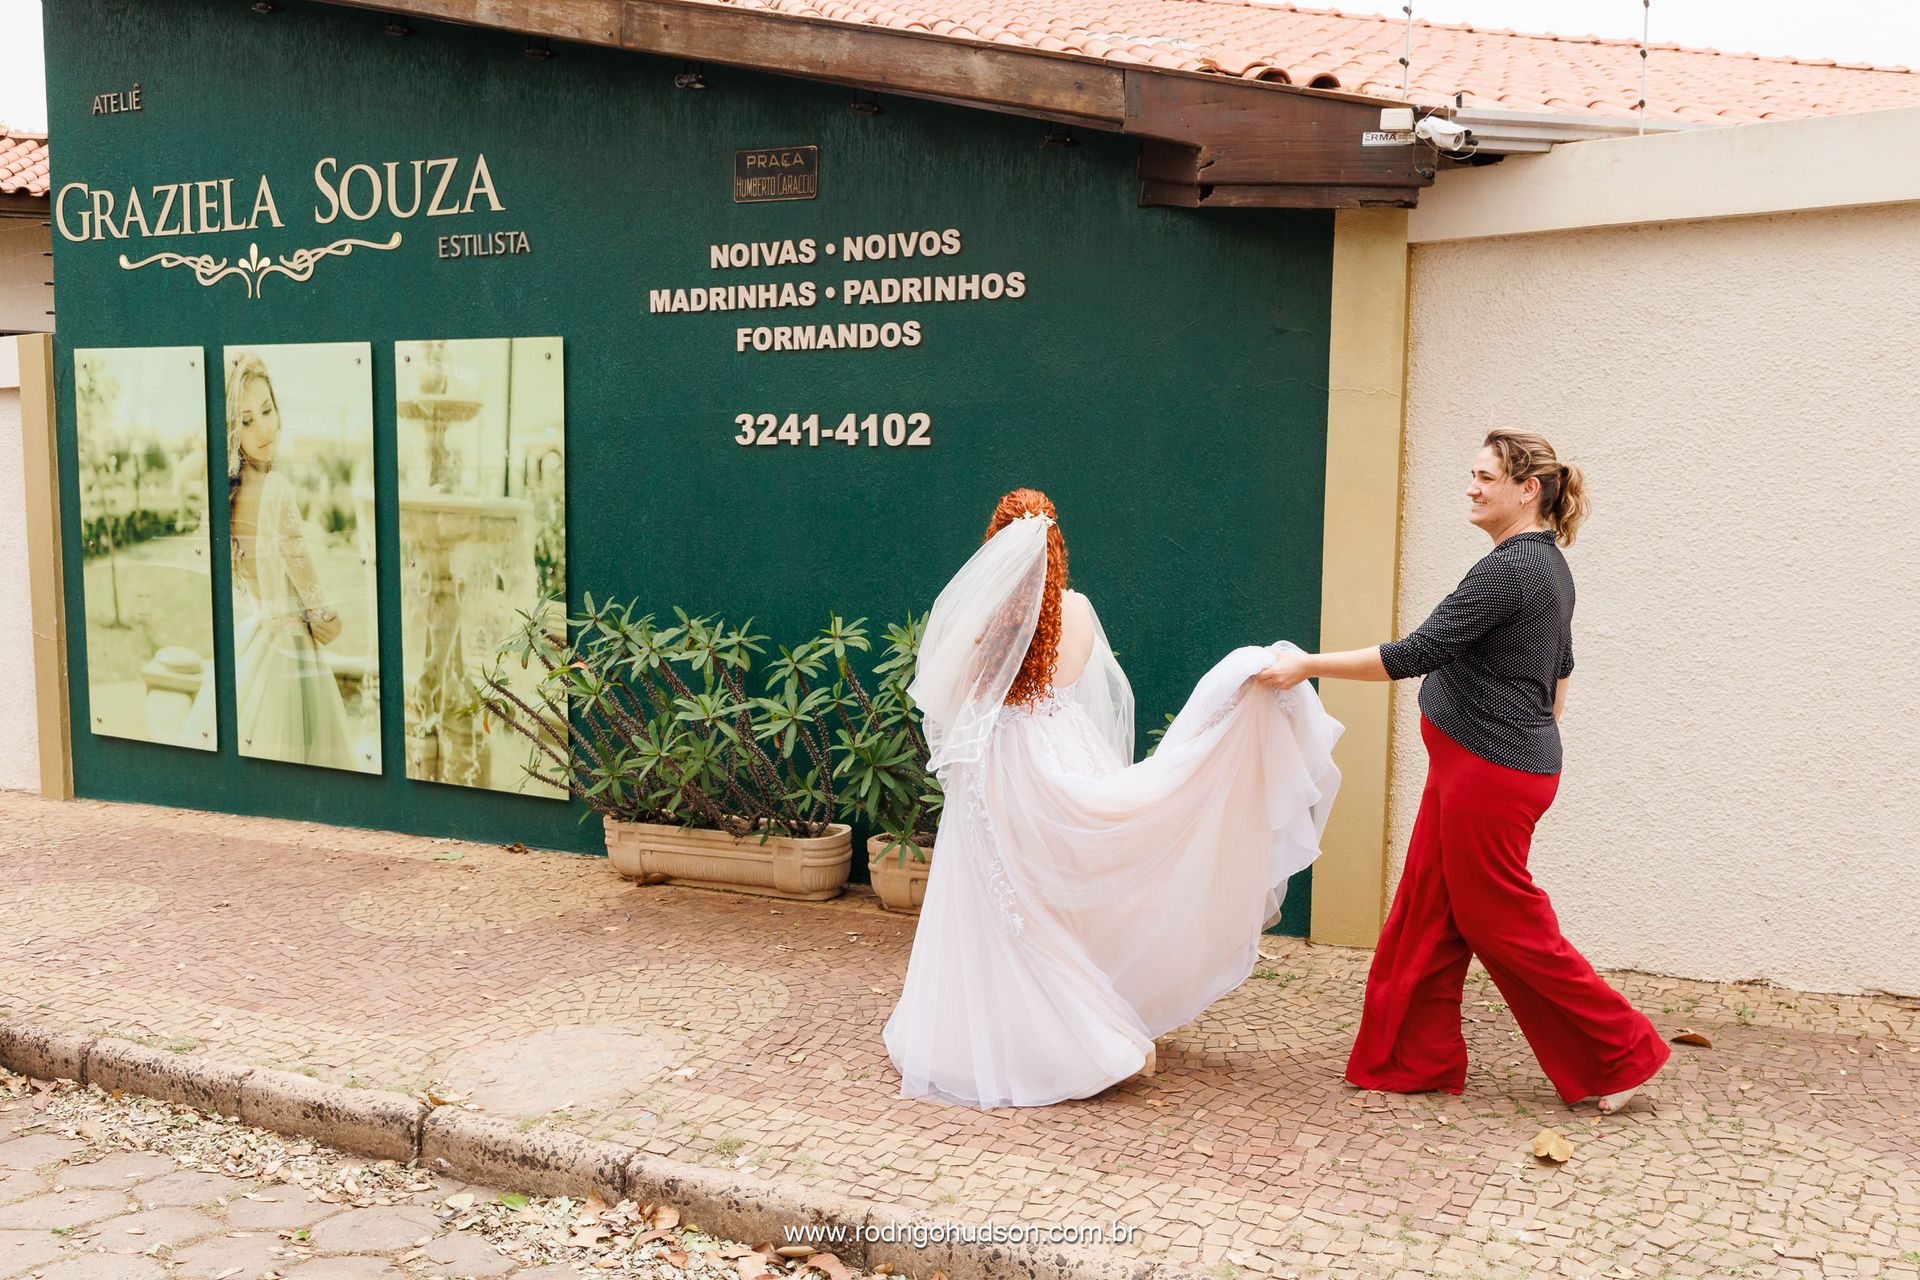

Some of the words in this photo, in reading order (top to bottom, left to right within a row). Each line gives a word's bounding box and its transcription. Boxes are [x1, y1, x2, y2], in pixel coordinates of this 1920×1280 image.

[92, 83, 142, 115] ATELIÊ
[746, 152, 805, 169] PRAÇA
[55, 174, 284, 242] GRAZIELA
[314, 153, 506, 225] SOUZA
[736, 176, 776, 198] HUMBERTO
[438, 231, 531, 260] ESTILISTA
[710, 238, 817, 269] NOIVAS
[842, 229, 962, 262] NOIVOS
[649, 281, 817, 313] MADRINHAS
[843, 271, 1027, 305] PADRINHOS
[736, 320, 922, 352] FORMANDOS
[734, 412, 932, 447] 3241-4102
